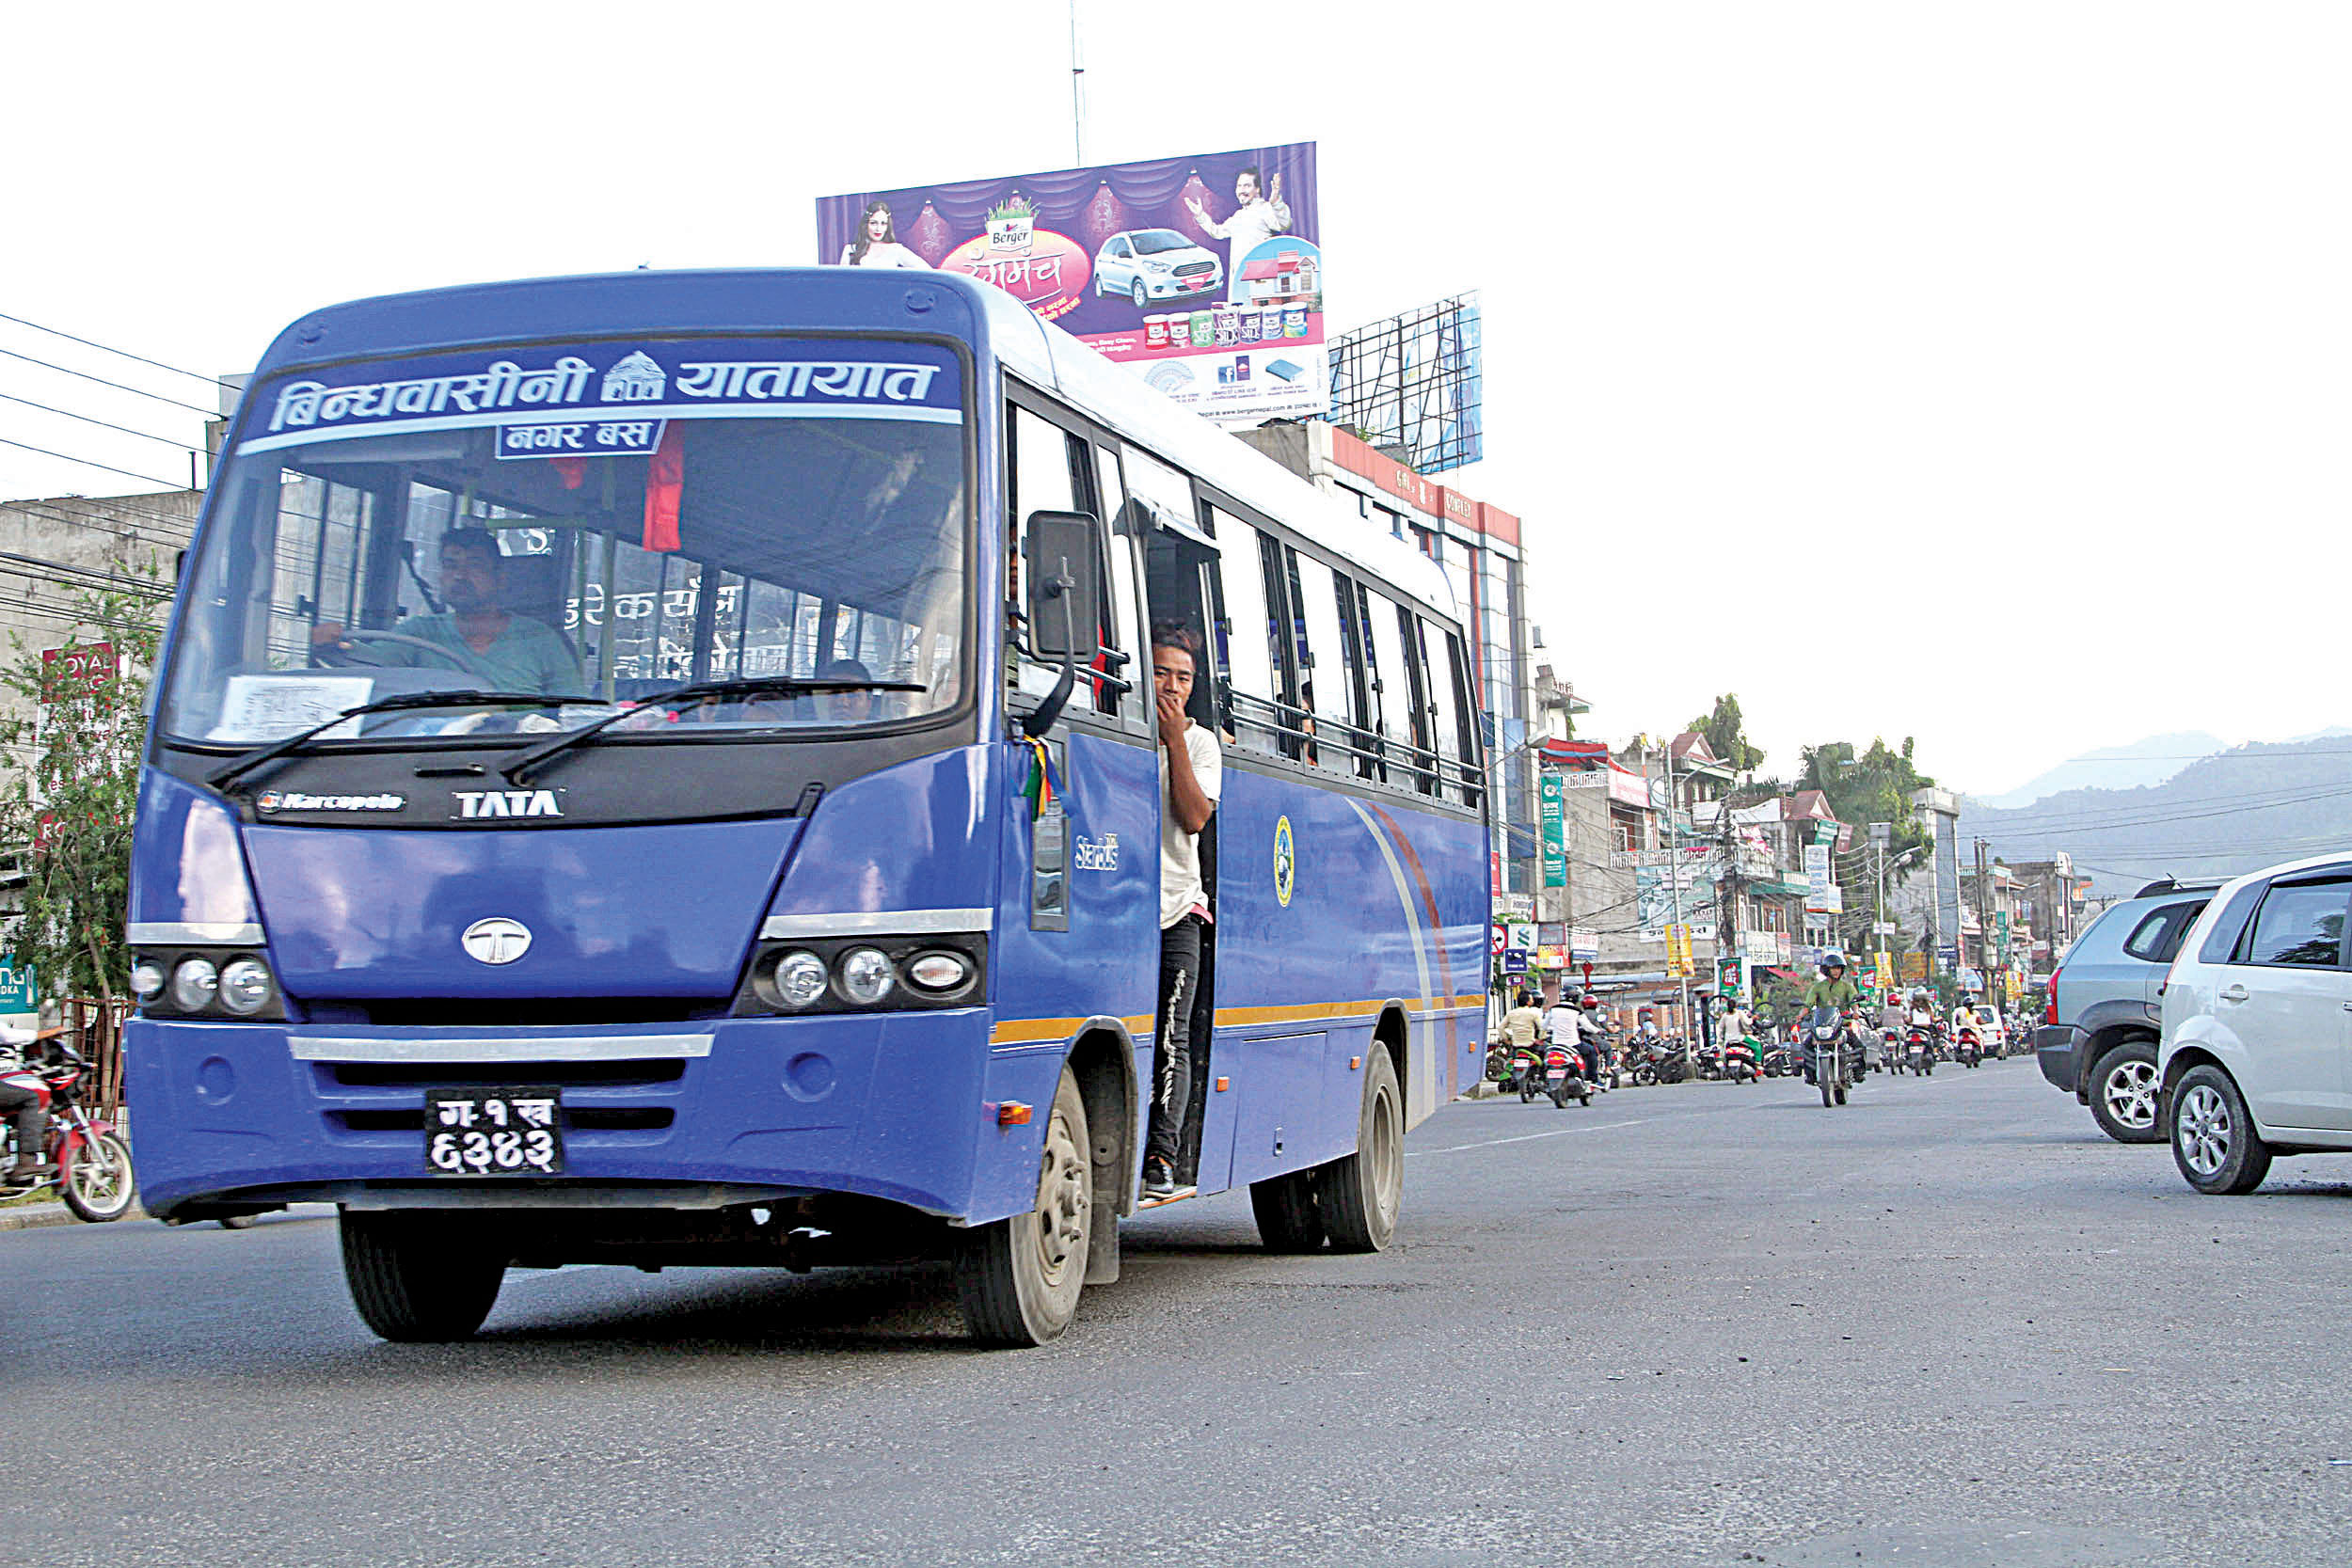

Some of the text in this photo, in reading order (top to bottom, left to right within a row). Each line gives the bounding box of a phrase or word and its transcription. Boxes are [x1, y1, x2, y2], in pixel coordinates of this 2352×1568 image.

[993, 230, 1028, 245] Berger
[676, 362, 941, 402] यातायात
[506, 422, 653, 450] नगर बस
[281, 789, 565, 818] Marcopolo TATA
[431, 1129, 555, 1175] ६३४३
